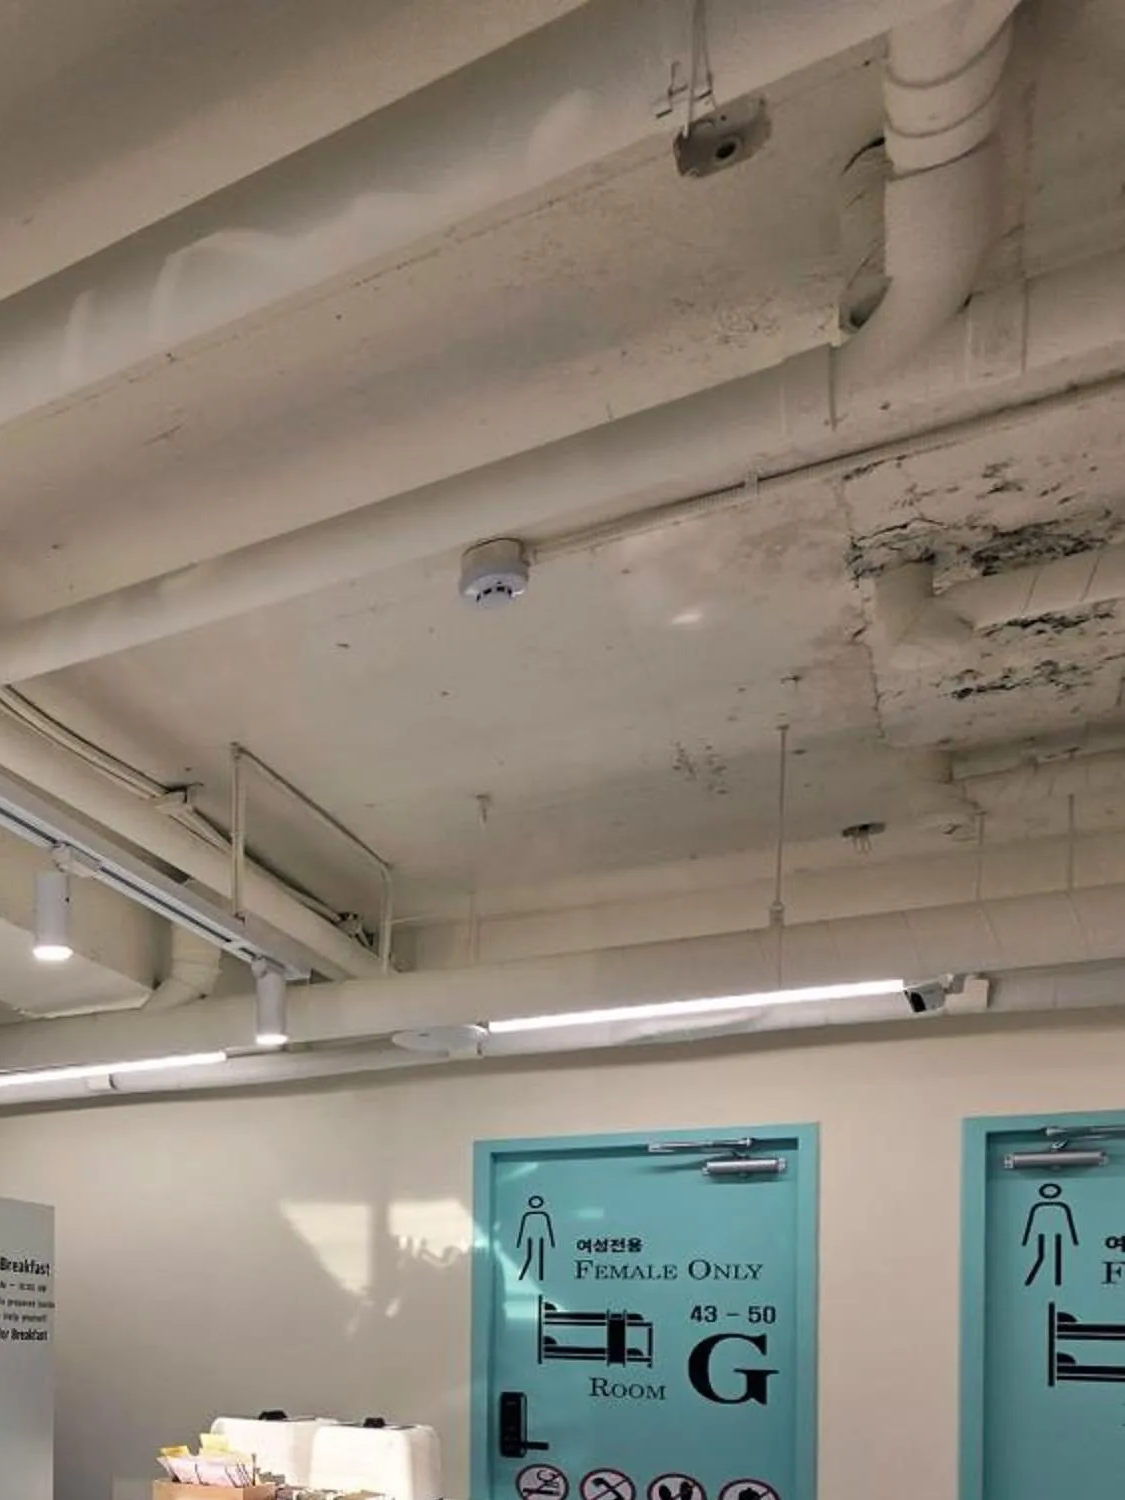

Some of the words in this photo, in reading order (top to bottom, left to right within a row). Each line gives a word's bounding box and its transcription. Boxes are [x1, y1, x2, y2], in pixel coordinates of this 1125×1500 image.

[576, 1237, 643, 1254] 여성전용
[0, 1256, 50, 1277] Breakfast
[690, 1305, 718, 1323] 43
[748, 1306, 777, 1324] 50
[11, 1327, 47, 1341] Breakfast
[687, 1332, 779, 1406] G
